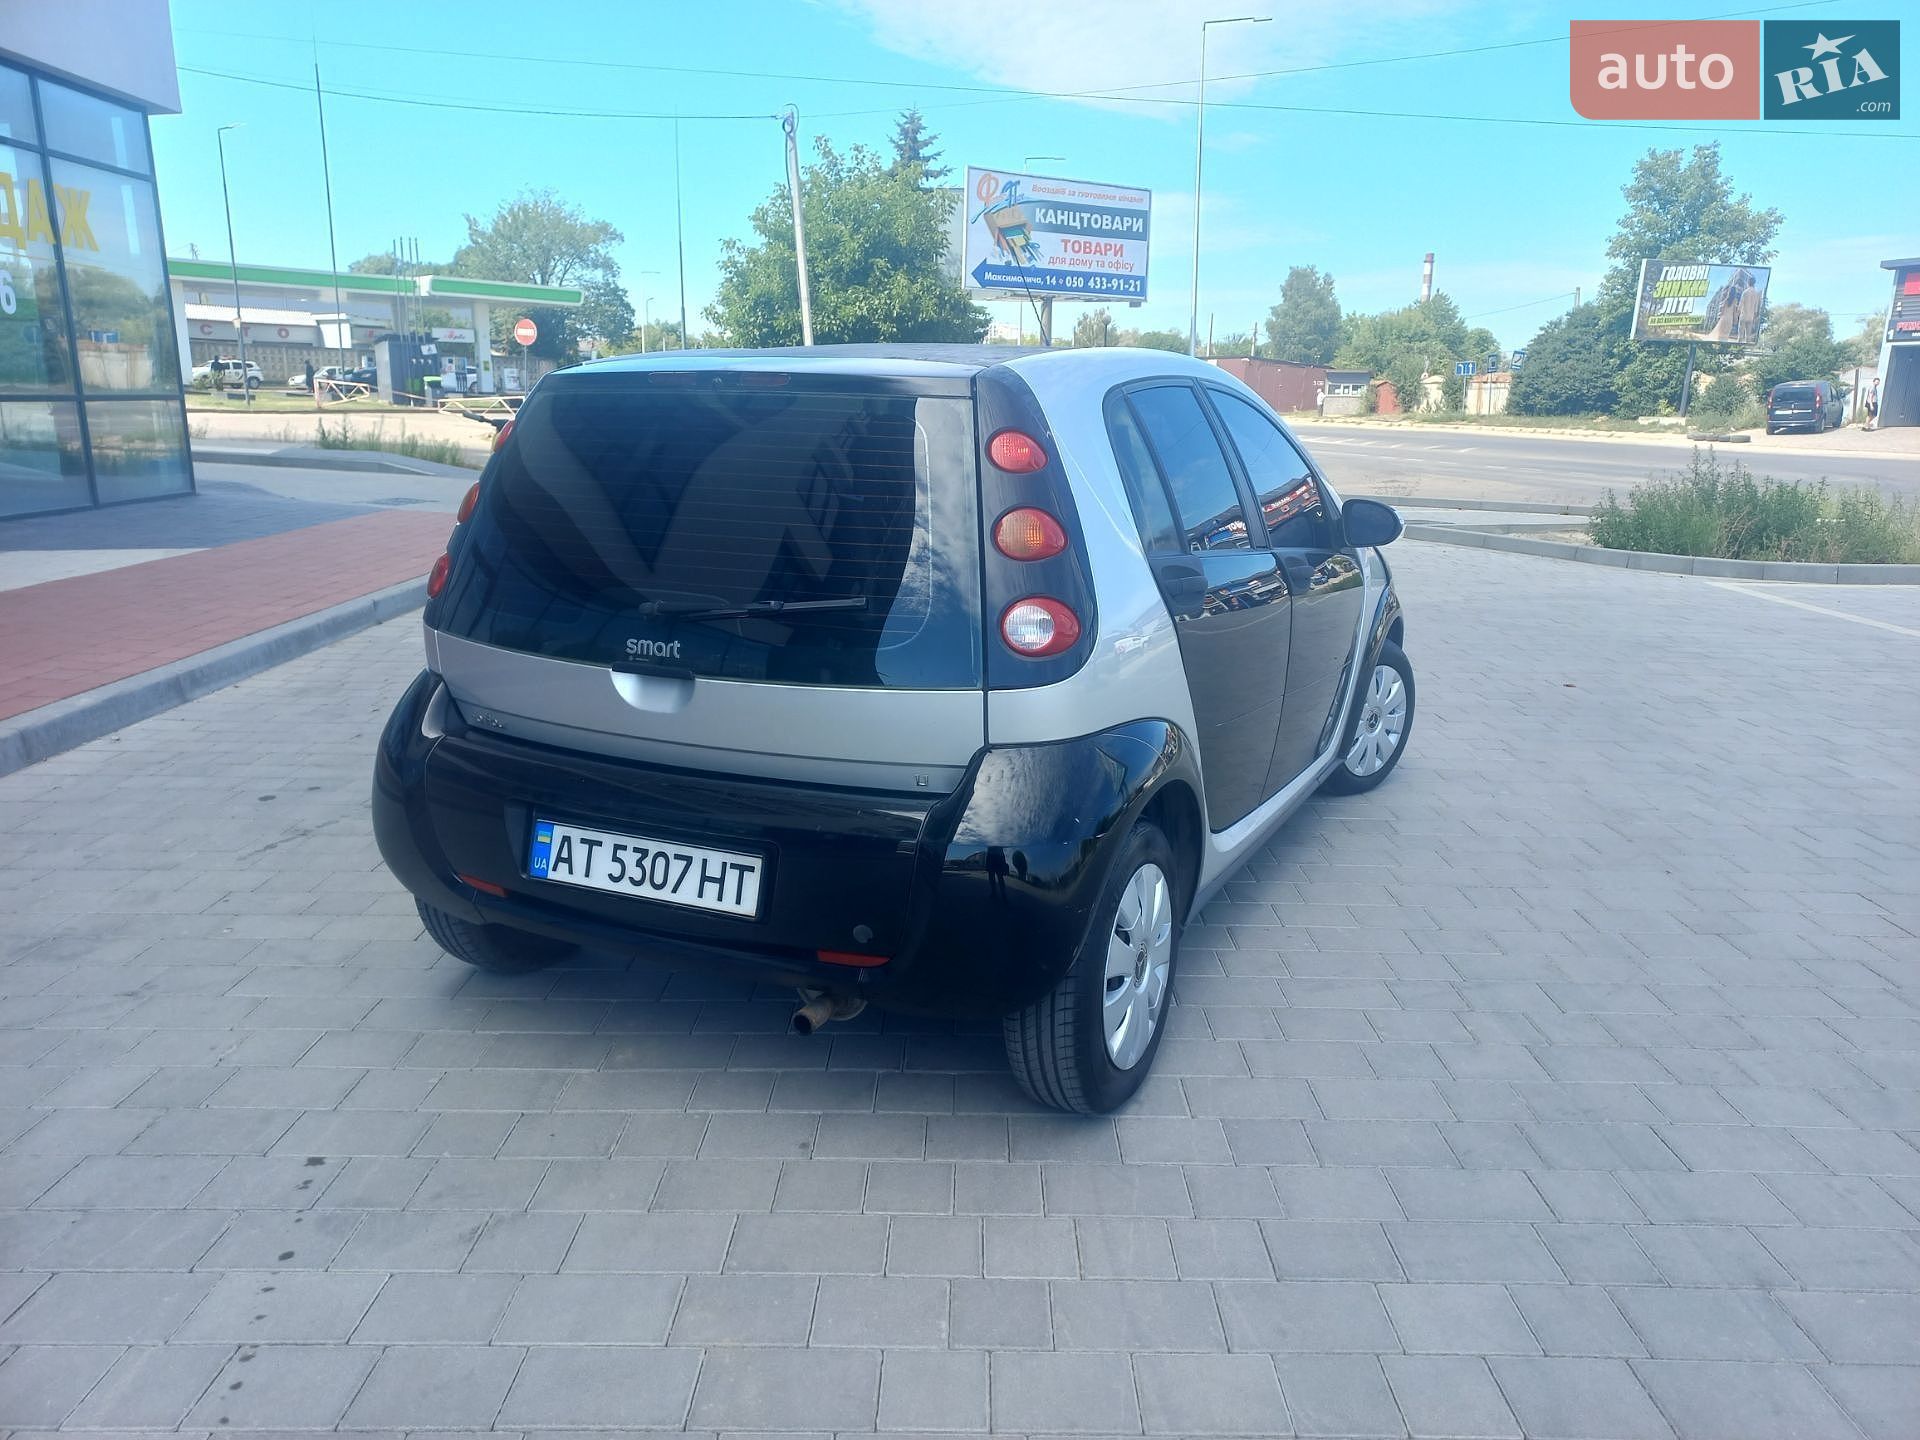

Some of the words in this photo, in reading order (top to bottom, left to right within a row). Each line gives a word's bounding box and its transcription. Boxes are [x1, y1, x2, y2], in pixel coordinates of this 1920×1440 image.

[1035, 207, 1144, 233] КАНЦТОВАРИ
[1060, 238, 1124, 257] ТОВАРИ
[1048, 256, 1066, 266] для
[1068, 257, 1093, 269] дому
[1095, 259, 1105, 268] та
[1107, 259, 1134, 273] офісу
[1659, 265, 1710, 281] ГОЛОВНІ
[1045, 275, 1056, 286] 14
[1065, 276, 1084, 288] 050
[1088, 278, 1141, 292] 433-91-21
[1653, 280, 1711, 298] ЗНИЖКИ
[1660, 297, 1695, 314] ЛІТА
[625, 638, 681, 659] smart
[533, 856, 547, 871] UA
[552, 834, 602, 878] AT
[607, 843, 693, 894] 5307
[697, 858, 755, 906] HT
